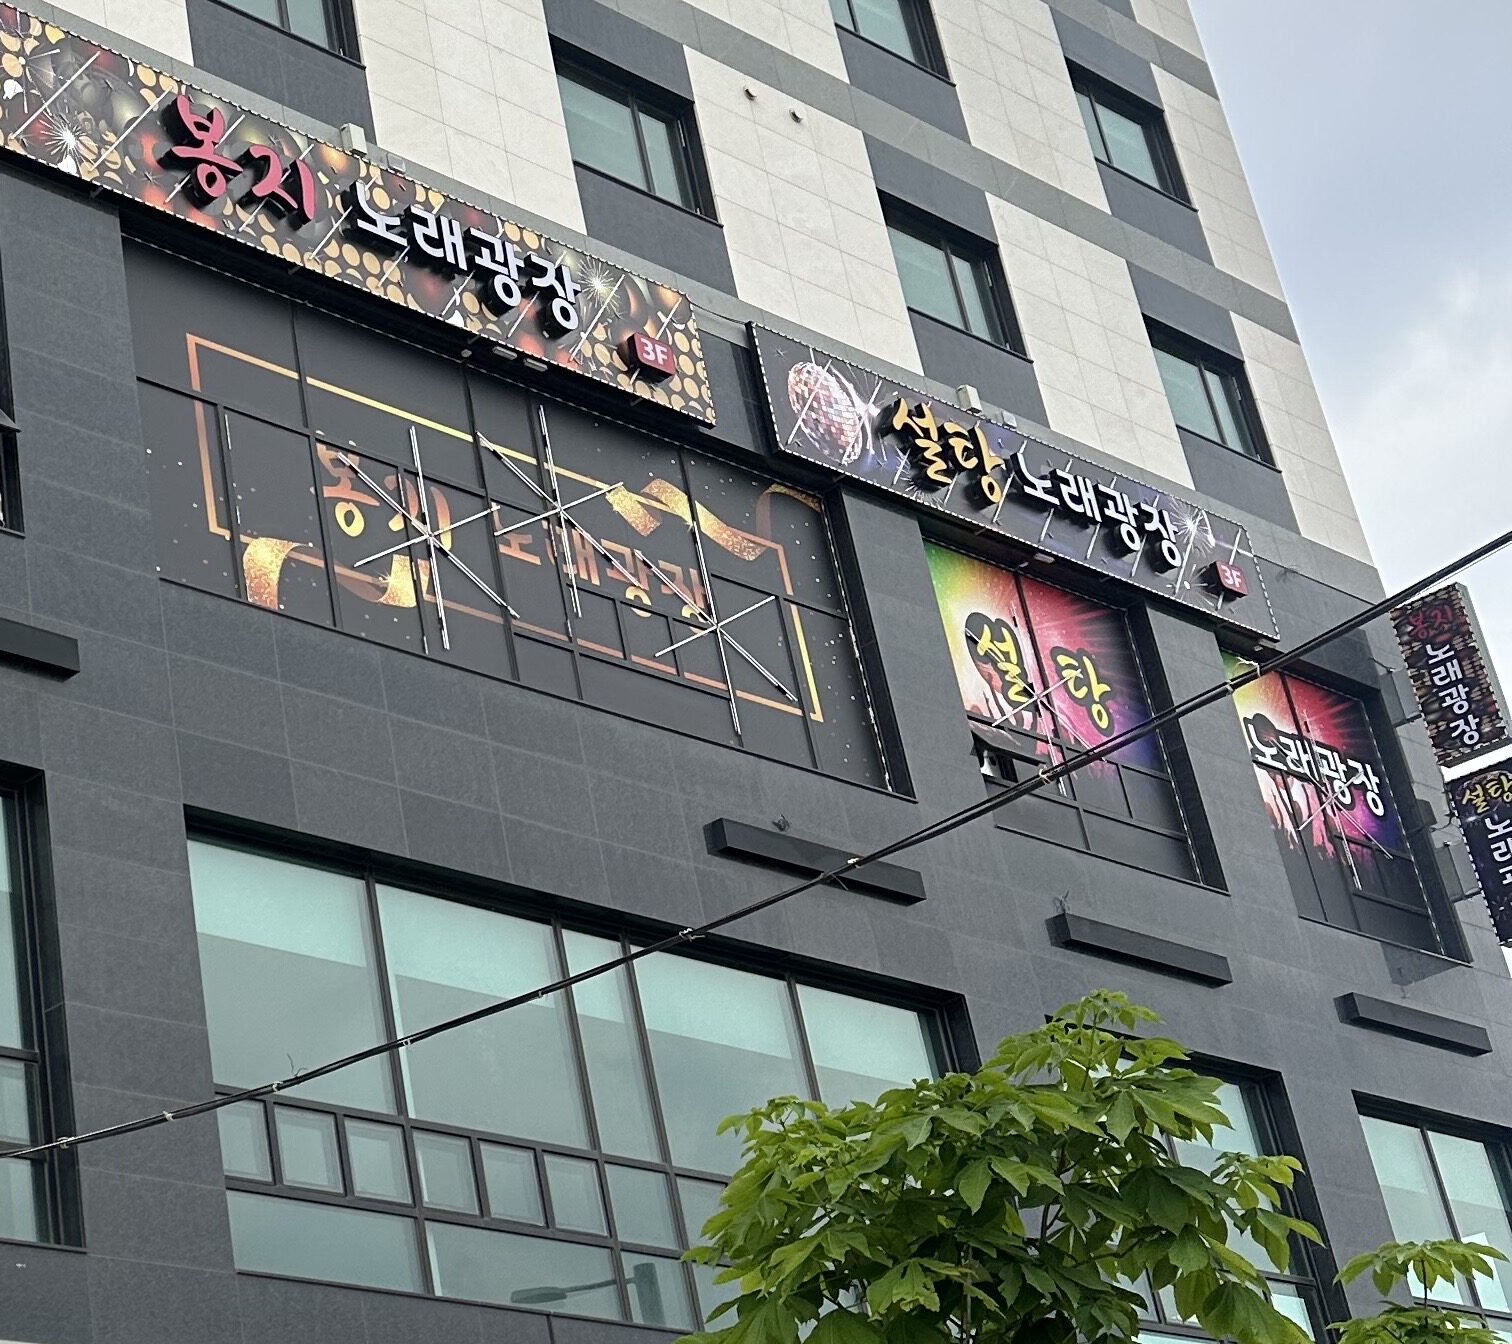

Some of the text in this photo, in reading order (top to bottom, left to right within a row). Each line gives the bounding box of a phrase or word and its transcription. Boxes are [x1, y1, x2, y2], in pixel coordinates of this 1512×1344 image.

[170, 93, 582, 331] 봉지 노래광장
[640, 335, 670, 366] 3F
[893, 398, 1182, 568] 설탕 노래광장
[1219, 563, 1243, 589] 3F
[977, 624, 1112, 730] 설탕
[1425, 642, 1481, 747] 노래광장
[1246, 721, 1385, 818] 노래광장
